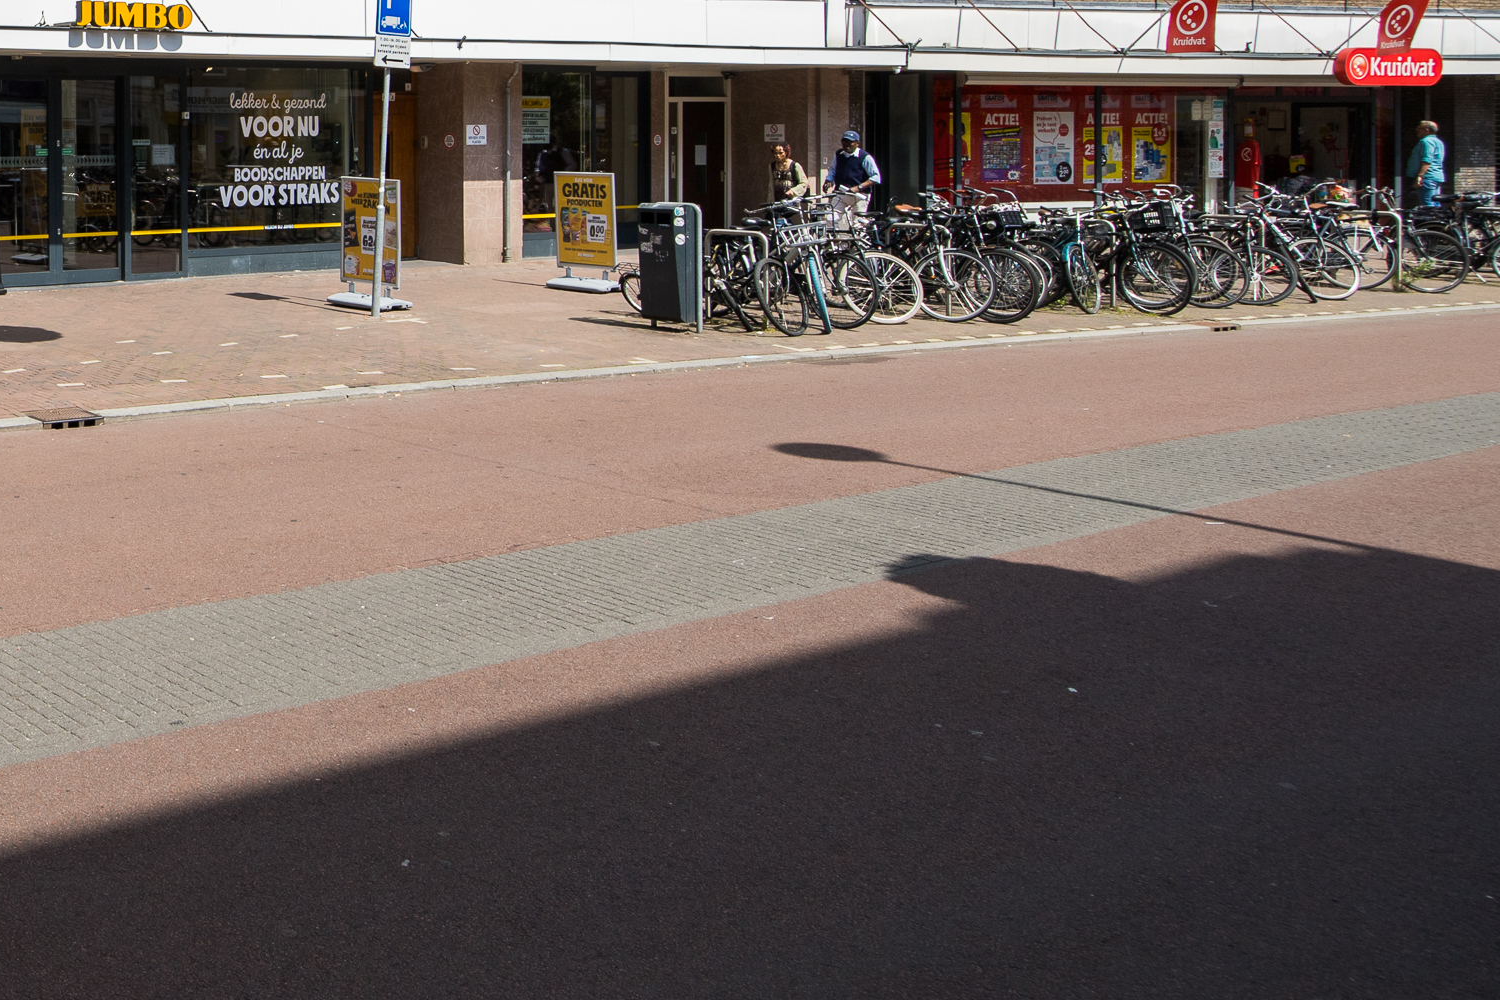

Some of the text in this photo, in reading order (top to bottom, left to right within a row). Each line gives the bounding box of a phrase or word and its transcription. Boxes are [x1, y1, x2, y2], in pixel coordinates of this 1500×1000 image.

[76, 0, 193, 30] JUMBO
[1172, 36, 1206, 46] Kruidvat
[1380, 40, 1405, 50] Kruidvat
[1370, 56, 1435, 77] Kruidvat
[229, 92, 269, 109] lekker
[271, 94, 281, 109] &
[283, 93, 327, 113] gezond
[240, 115, 320, 137] VOOR NU
[984, 113, 1020, 126] ACTIE!
[1086, 113, 1120, 125] ATIE!
[1135, 113, 1168, 125] ACTIE!
[1153, 127, 1167, 137] 1+1
[253, 140, 304, 164] én al je
[234, 166, 326, 182] BOODSCHAPPEN
[219, 182, 340, 208] VOOR STRAKS
[562, 183, 607, 200] GRATIS
[363, 199, 391, 215] ZAKN
[566, 198, 603, 208] PRODUCTEN
[362, 234, 376, 248] 62
